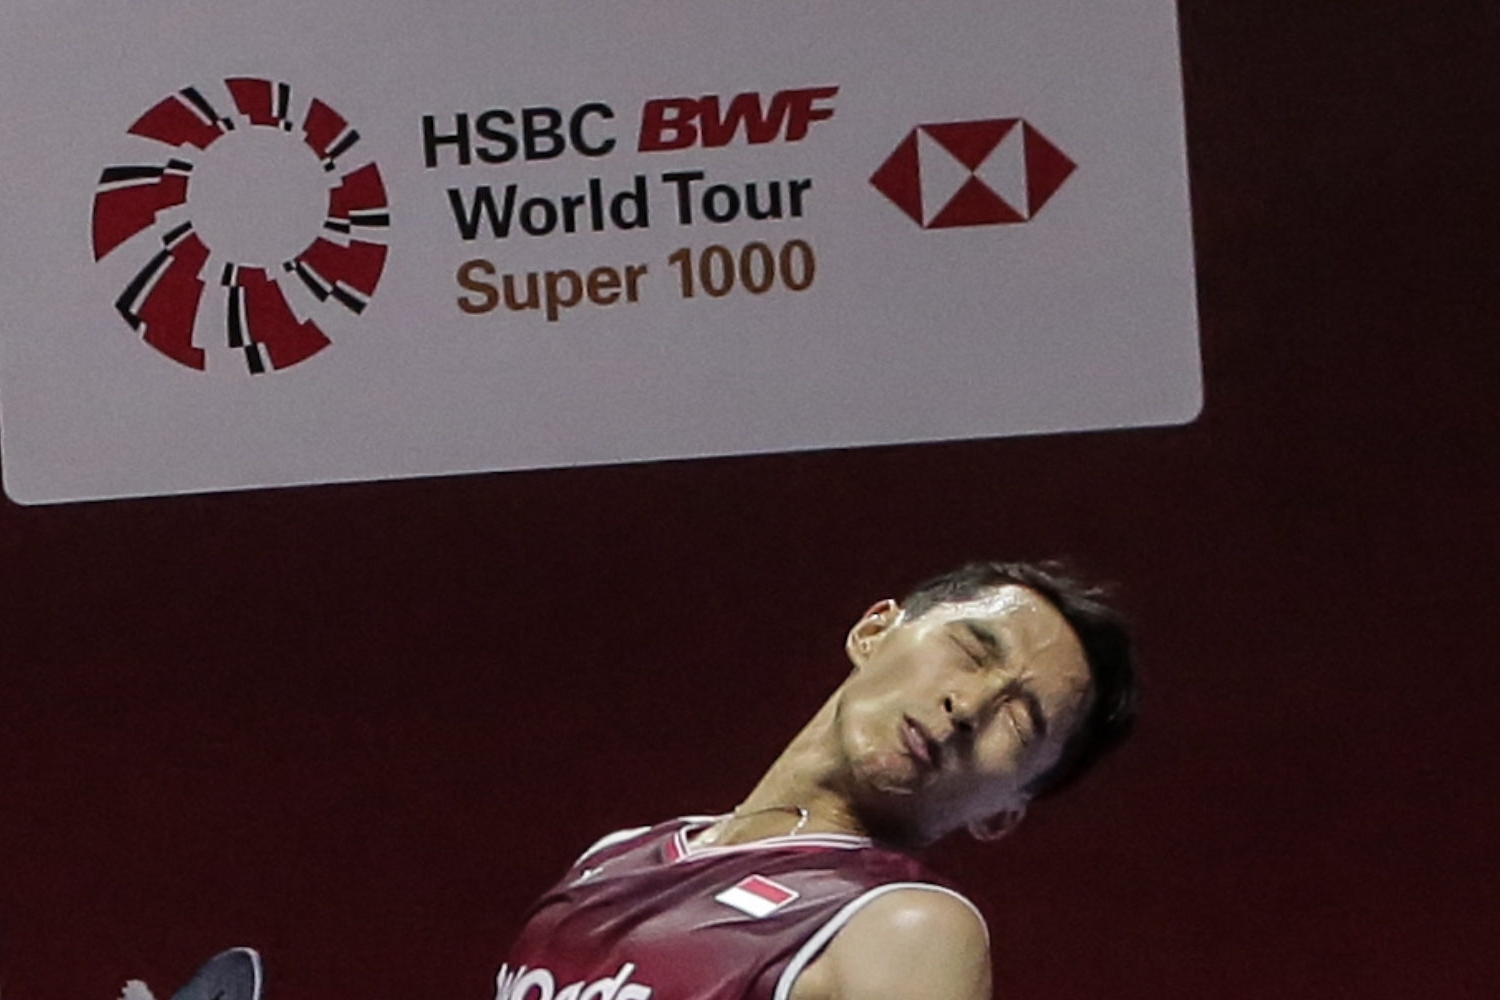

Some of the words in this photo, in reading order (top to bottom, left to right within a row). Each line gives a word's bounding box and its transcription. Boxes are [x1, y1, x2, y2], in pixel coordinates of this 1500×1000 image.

[422, 103, 617, 169] HSBC
[636, 85, 841, 154] BWF
[446, 175, 650, 241] World
[661, 170, 813, 226] Tour
[456, 258, 649, 323] Super
[667, 238, 817, 299] 1000
